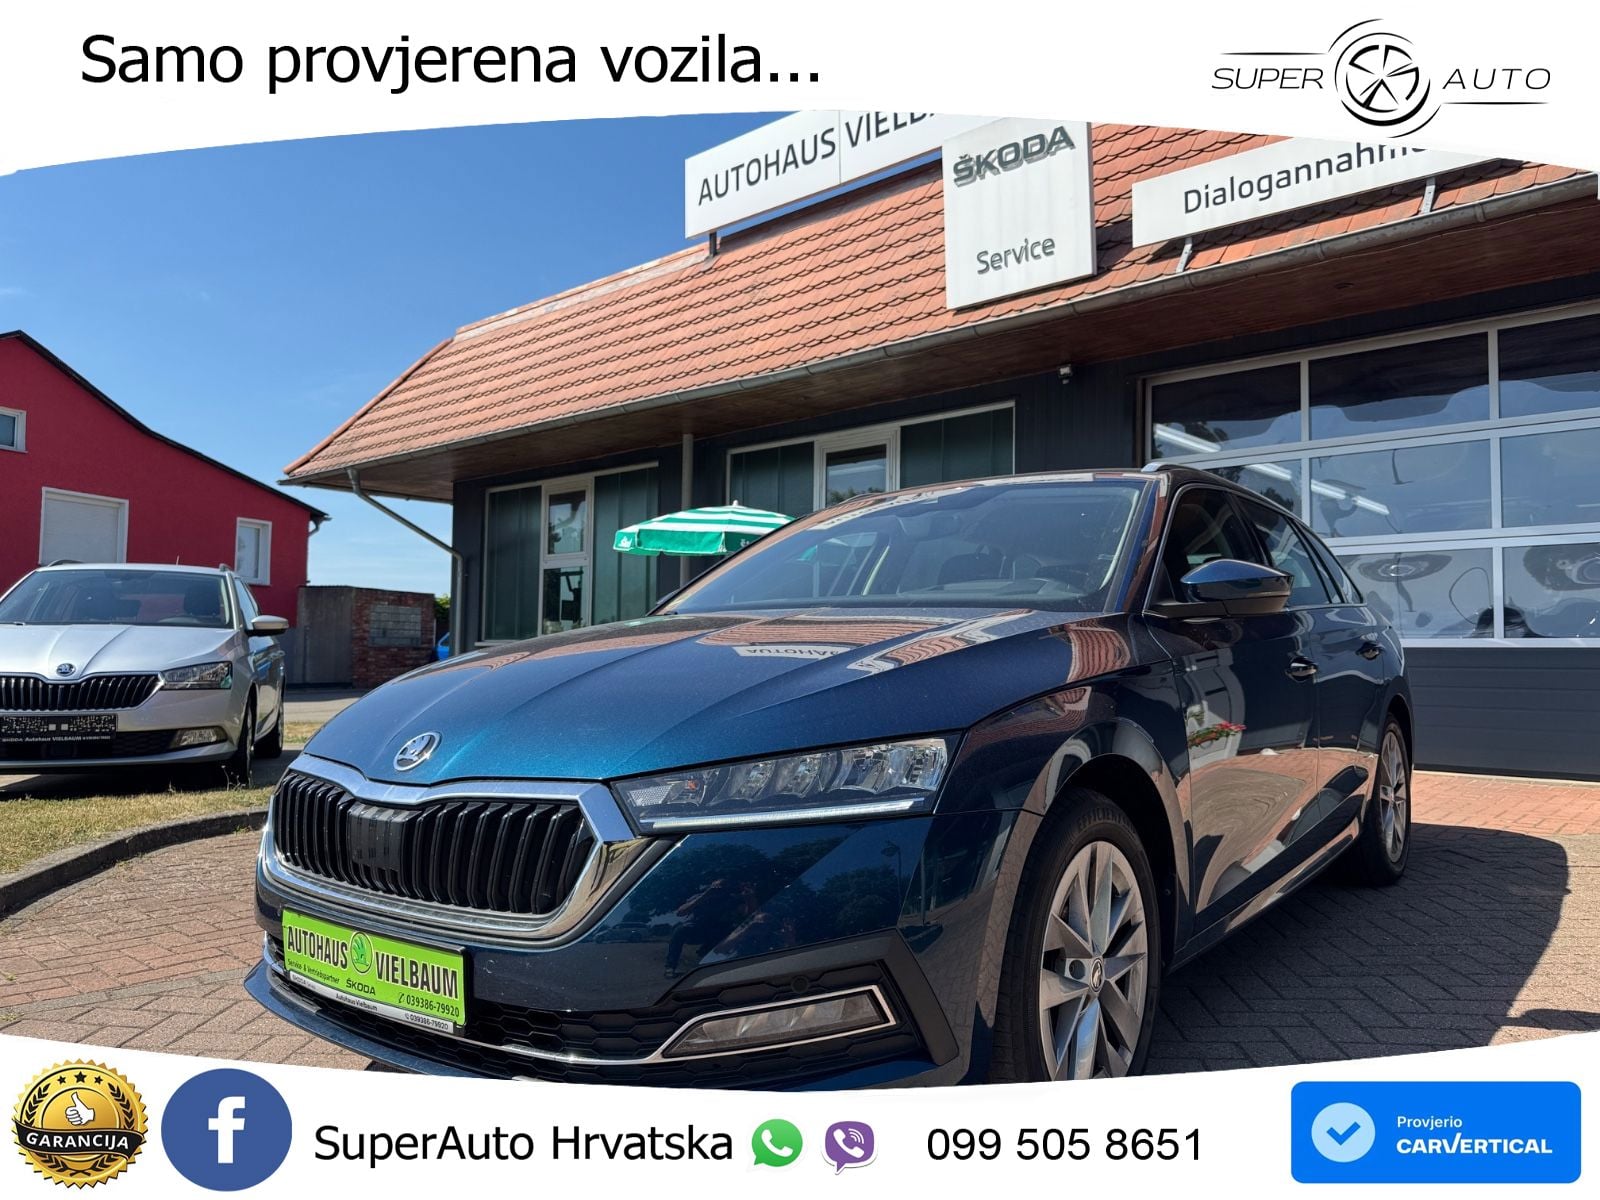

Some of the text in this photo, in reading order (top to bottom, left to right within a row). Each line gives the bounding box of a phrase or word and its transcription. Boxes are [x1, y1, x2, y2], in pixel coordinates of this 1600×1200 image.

[698, 128, 836, 207] AUTOHAUS
[953, 125, 1075, 187] ŠKODA
[976, 237, 1056, 276] Service
[287, 926, 459, 999] AUTOHAUS VIELBAUM
[345, 977, 376, 996] ŠKODA
[356, 1000, 378, 1012] Vielbaum
[406, 995, 460, 1017] 039386-79920
